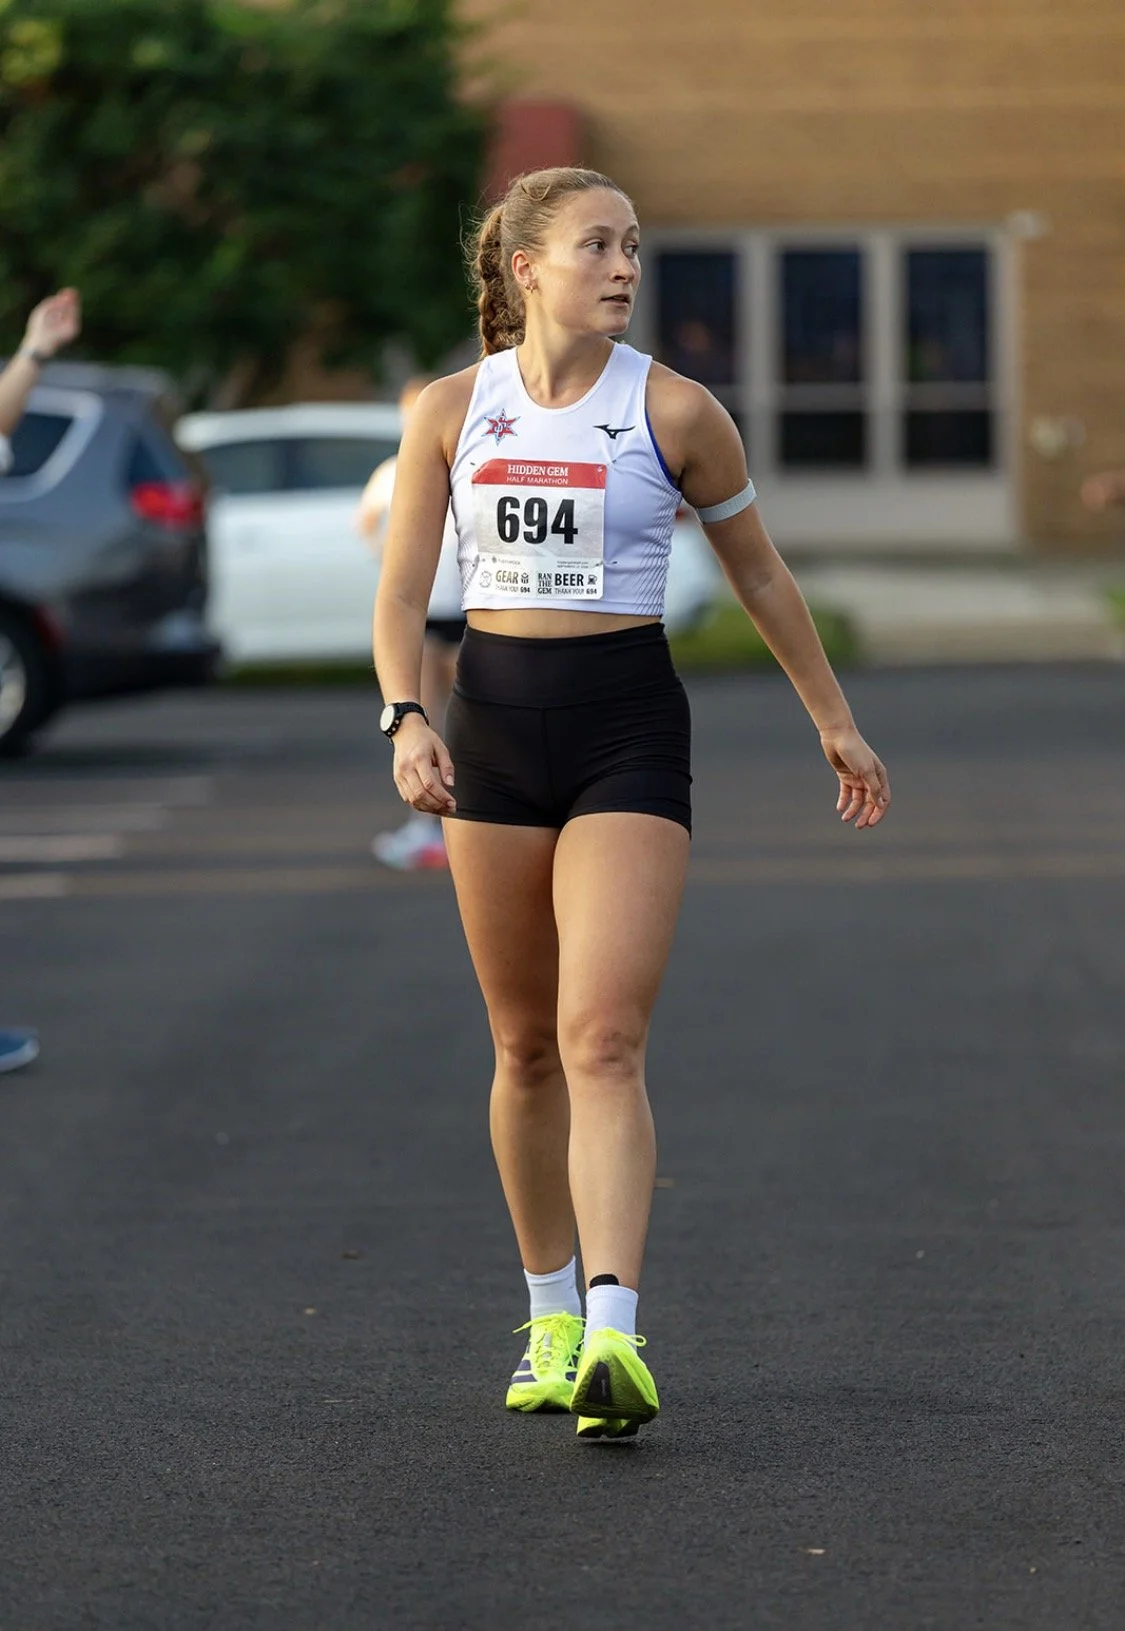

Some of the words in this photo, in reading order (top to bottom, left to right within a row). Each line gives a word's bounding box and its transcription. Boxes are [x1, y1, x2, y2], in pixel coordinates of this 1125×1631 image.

[507, 464, 546, 475] HIDDEN
[547, 466, 569, 477] GEM
[527, 477, 568, 485] MARATHON
[497, 496, 578, 544] 694
[496, 570, 519, 584] GEAR
[538, 572, 552, 580] RAN
[554, 573, 584, 587] BEER
[537, 587, 552, 595] GEM
